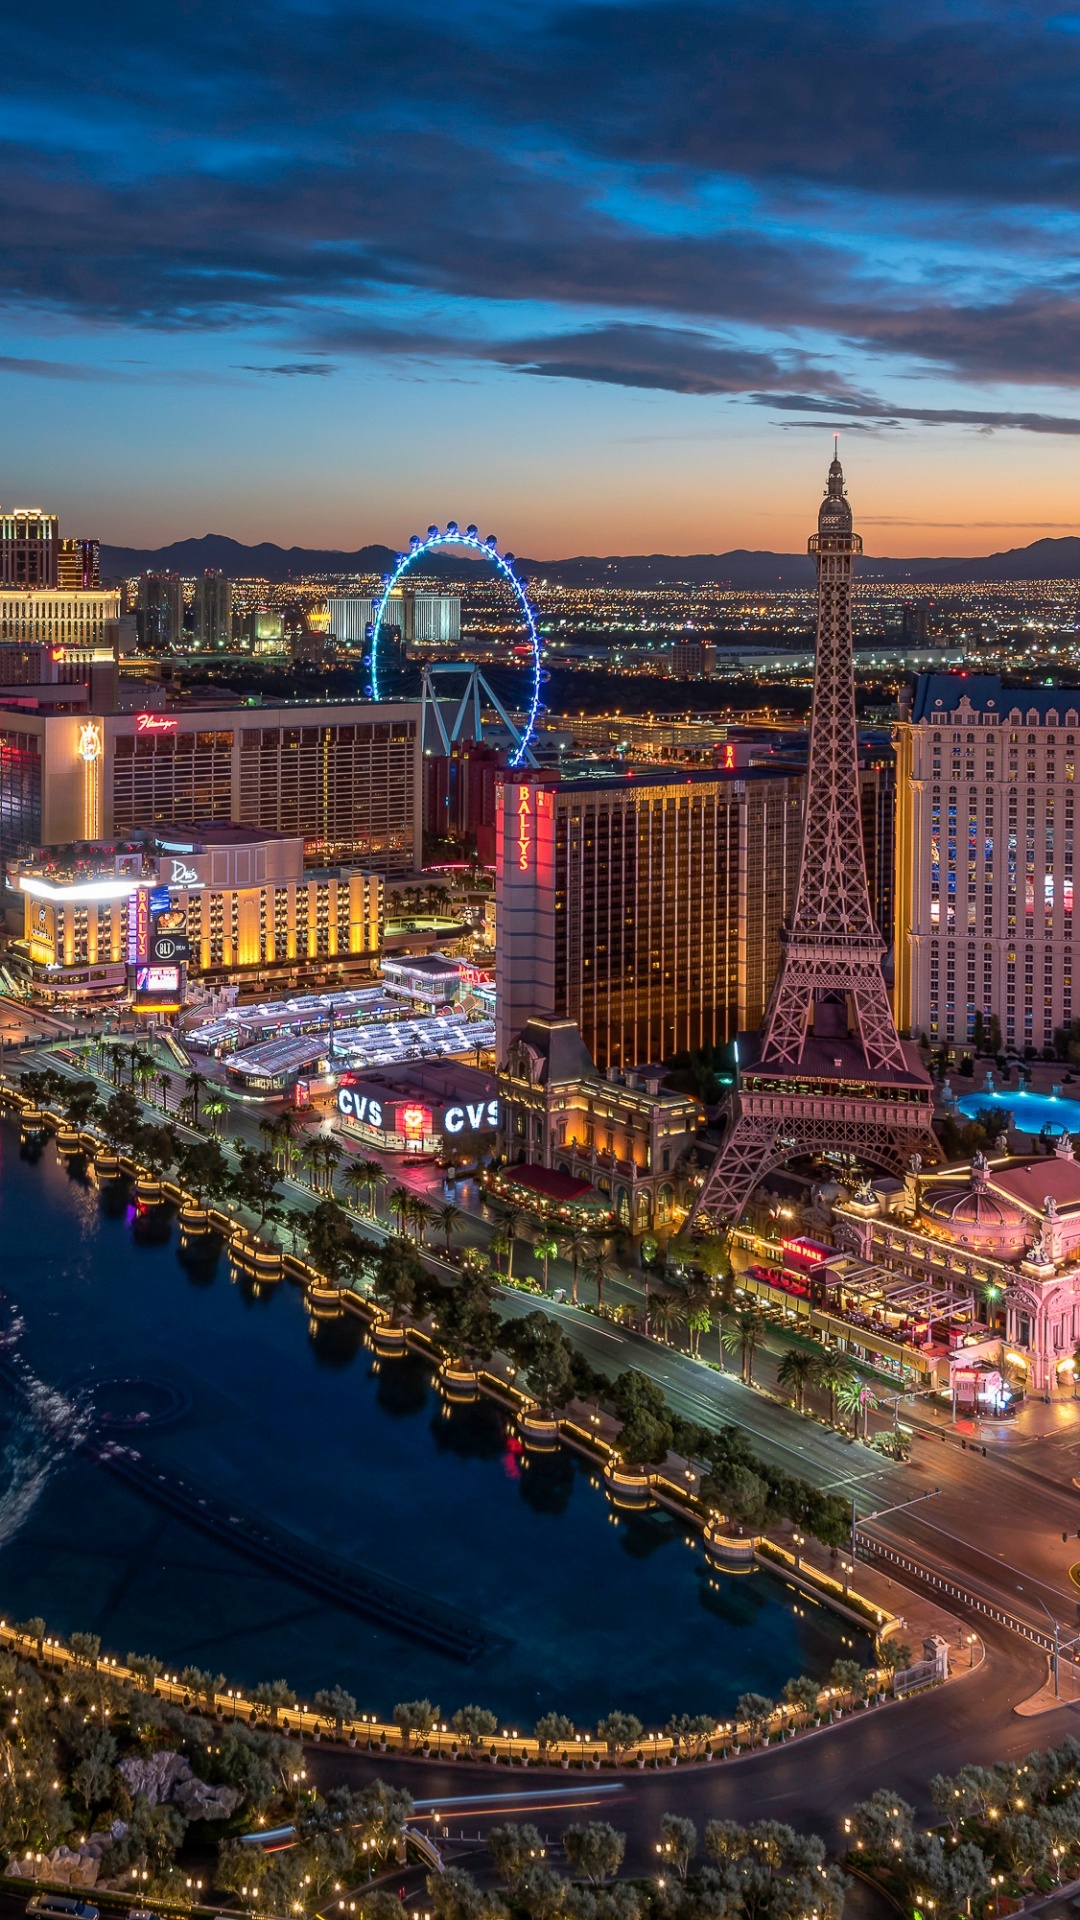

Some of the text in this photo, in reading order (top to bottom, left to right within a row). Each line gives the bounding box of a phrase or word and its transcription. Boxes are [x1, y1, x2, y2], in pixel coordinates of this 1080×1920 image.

[517, 786, 531, 871] BALLYS
[138, 891, 147, 955] BALLYS
[160, 943, 171, 954] BLT
[338, 1088, 383, 1127] CVS
[802, 1247, 822, 1262] PARK
